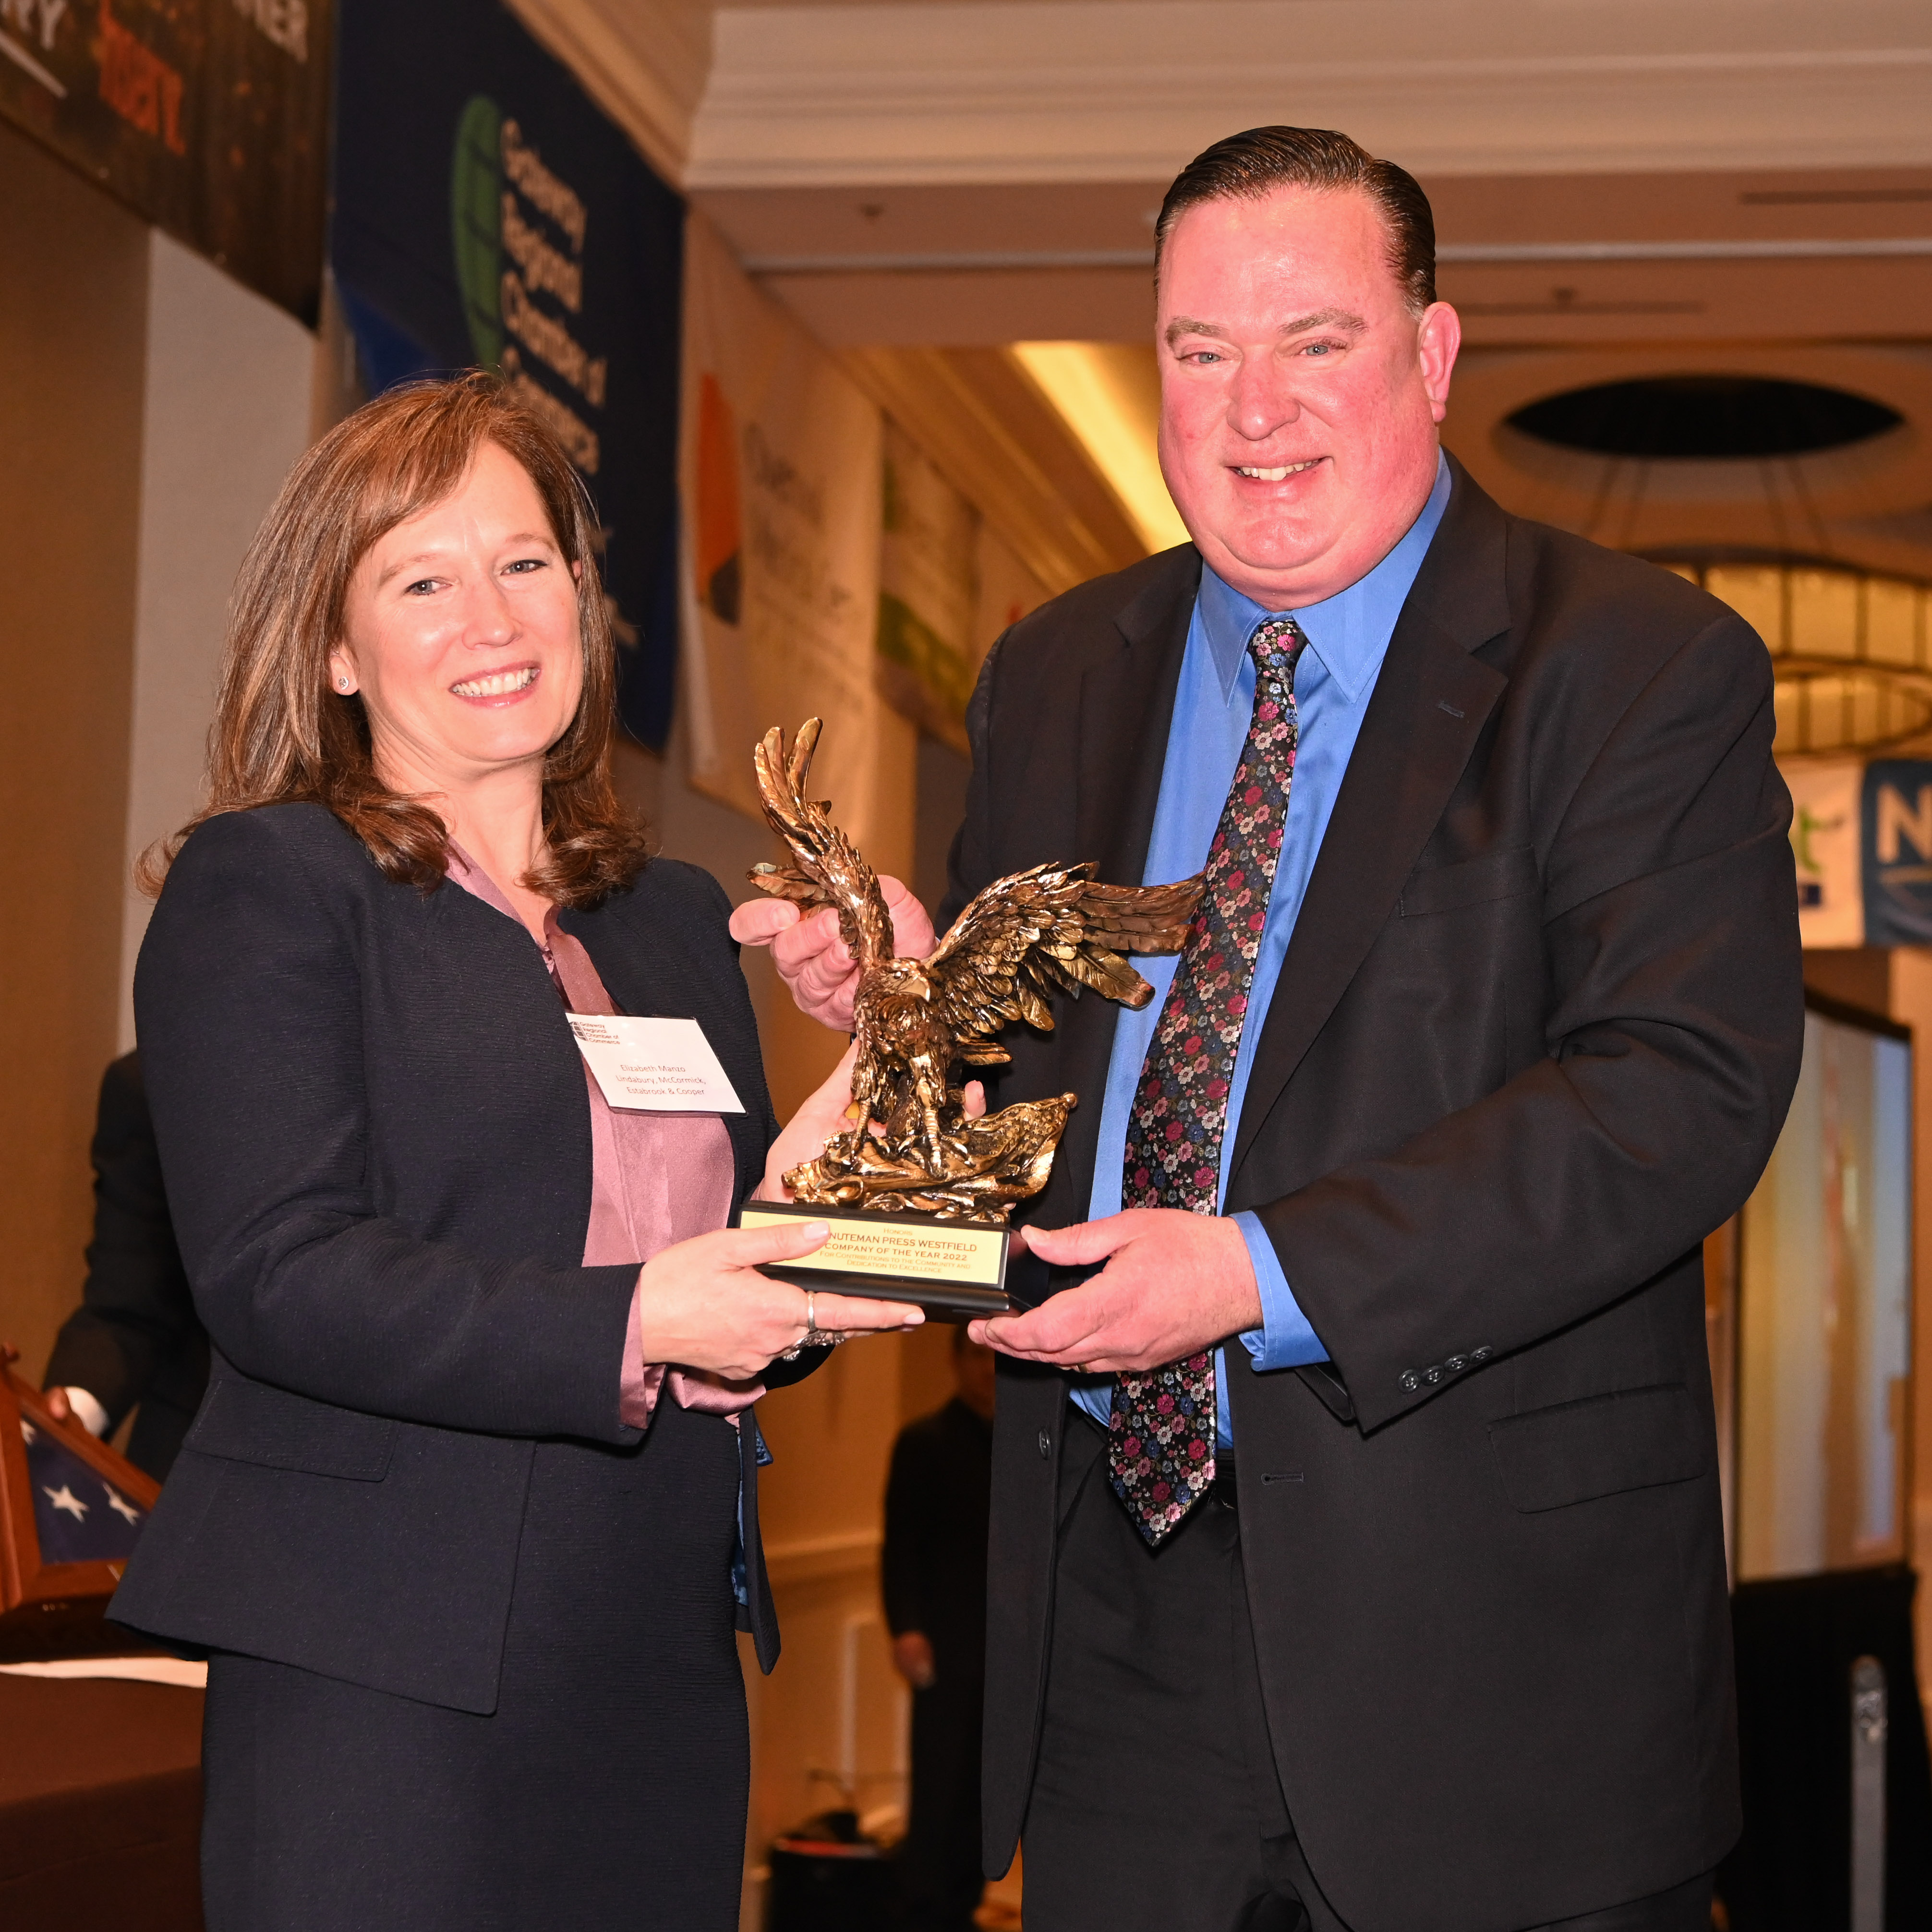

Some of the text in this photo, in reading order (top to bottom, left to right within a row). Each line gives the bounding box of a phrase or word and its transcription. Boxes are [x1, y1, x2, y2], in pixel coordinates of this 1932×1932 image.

[616, 1075, 706, 1085] Lindabury, McCormick,
[626, 1087, 667, 1095] Estabrook
[830, 1232, 977, 1252] NUTEMAN PRESS WESTFIELD
[825, 1243, 874, 1253] COMPANY
[914, 1250, 941, 1259] YEAR
[942, 1253, 967, 1261] 2022
